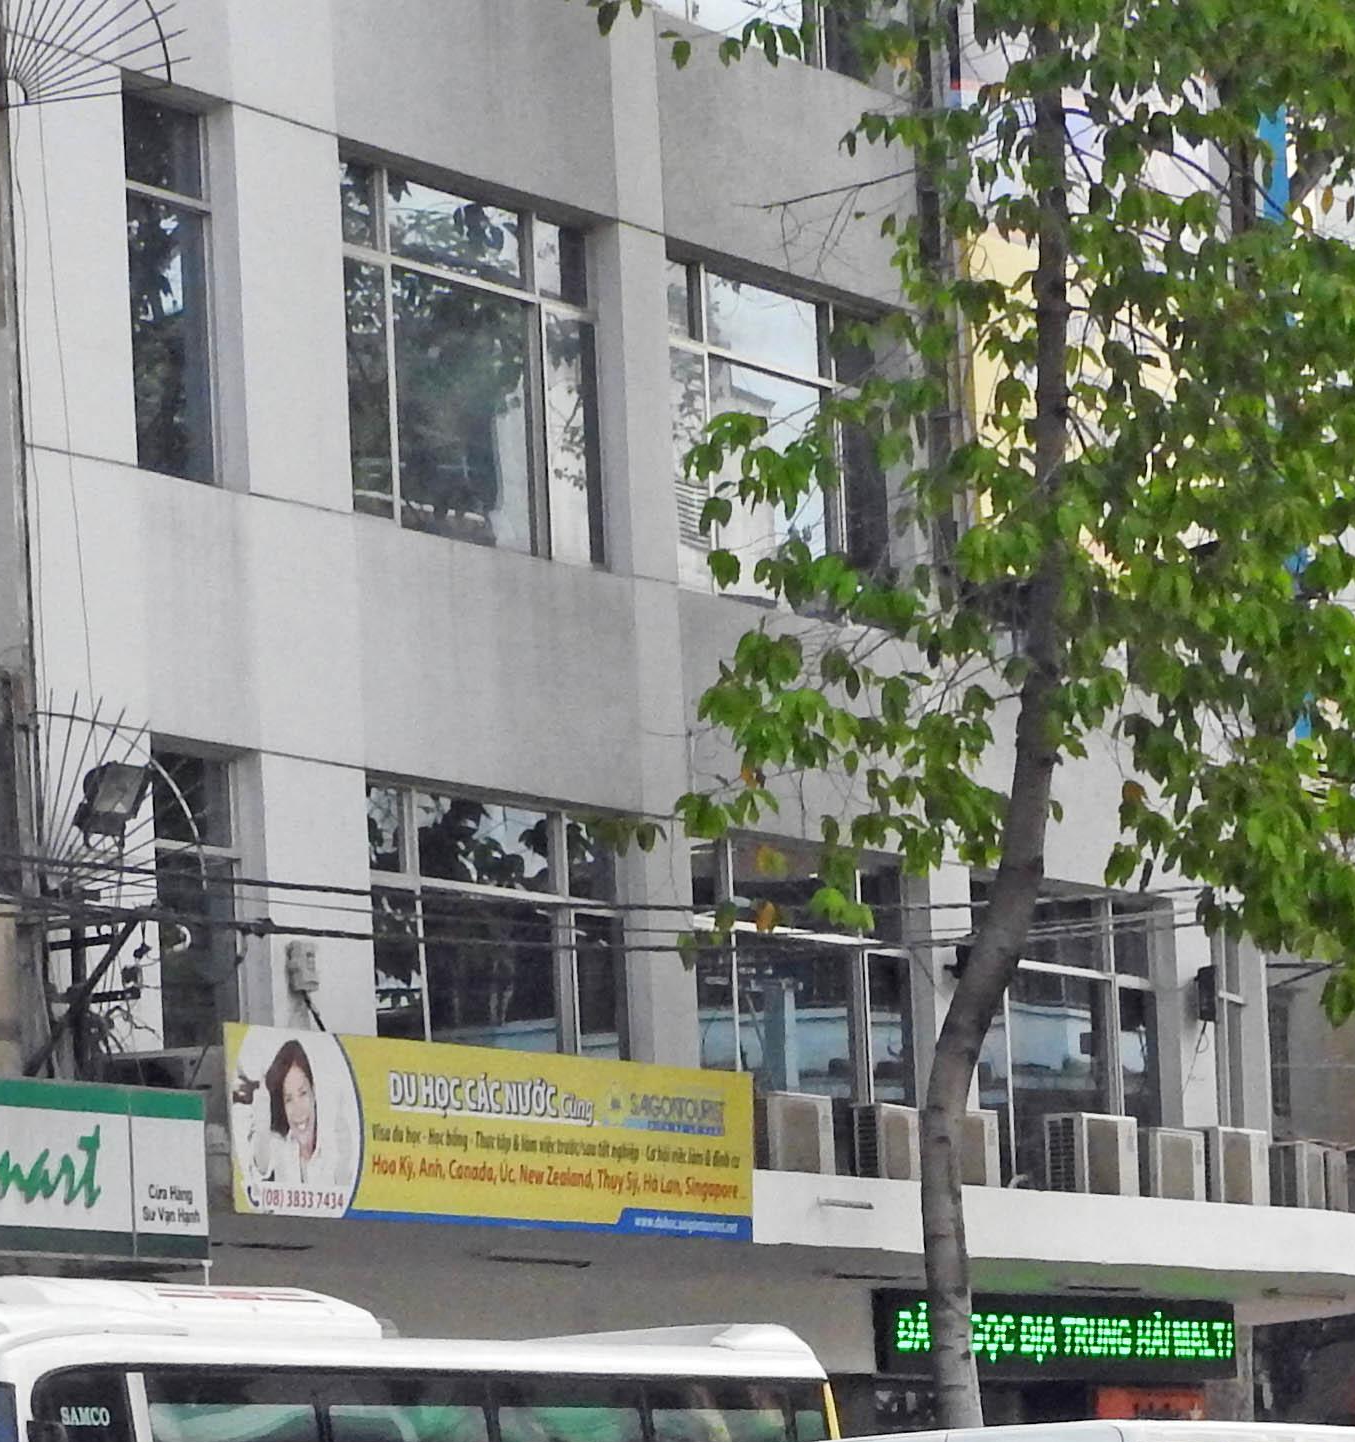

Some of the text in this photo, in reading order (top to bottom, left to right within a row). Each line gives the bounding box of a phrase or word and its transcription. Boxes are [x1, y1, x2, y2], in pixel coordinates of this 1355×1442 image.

[389, 1071, 418, 1105] DU
[420, 1074, 462, 1118] HỌC
[464, 1072, 501, 1113] CÁC
[505, 1076, 559, 1118] NƯỚC
[372, 1154, 395, 1175] Hoa
[449, 1160, 497, 1185] Canada,
[520, 1164, 544, 1185] New
[547, 1165, 594, 1192] Zealand,
[261, 1188, 284, 1208] (08)
[1061, 1316, 1132, 1357] TRUNG
[60, 1405, 111, 1427] SAMCO
